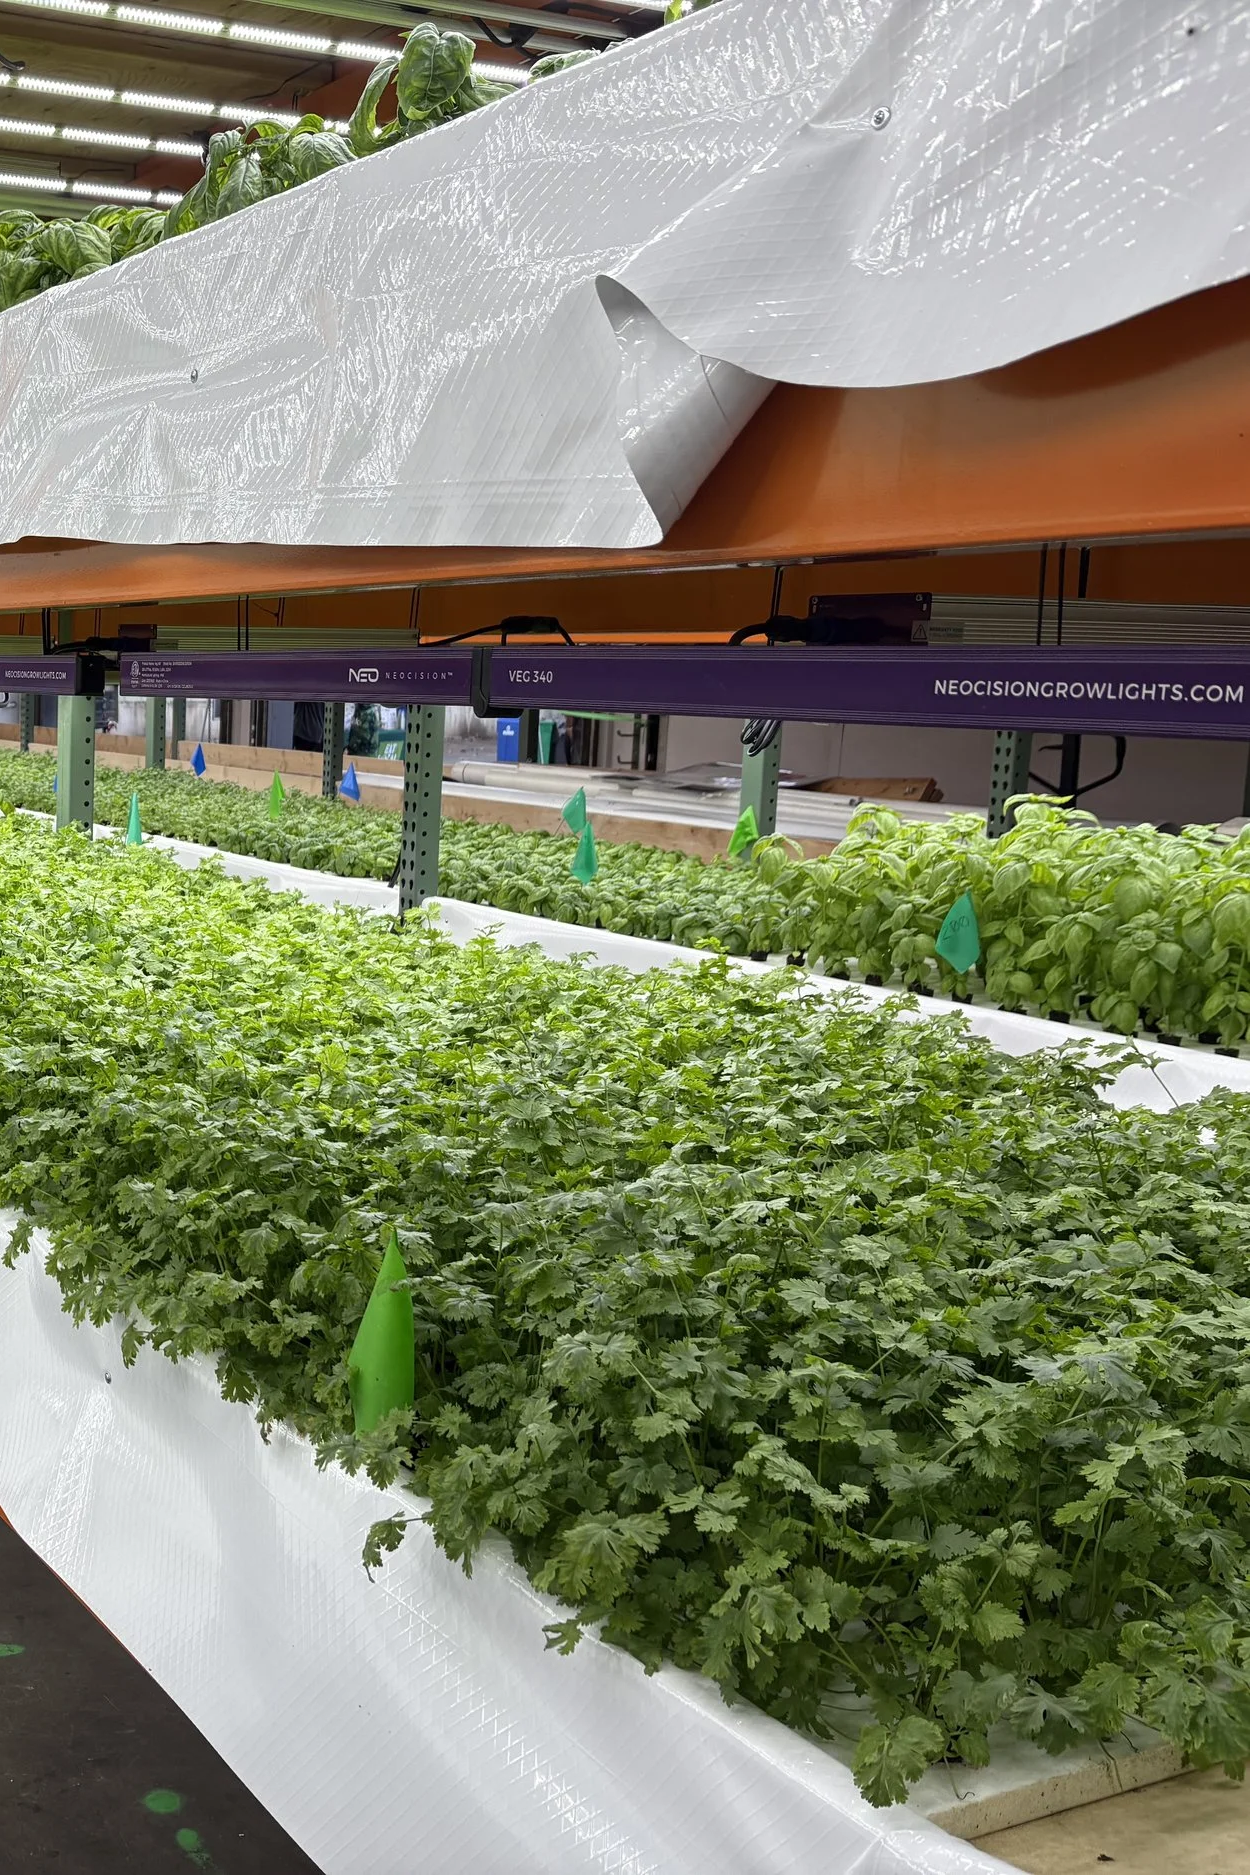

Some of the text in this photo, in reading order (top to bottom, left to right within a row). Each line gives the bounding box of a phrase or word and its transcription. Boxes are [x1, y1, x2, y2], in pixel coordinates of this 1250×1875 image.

[348, 668, 379, 683] NEO
[508, 670, 554, 683] VEG 340
[933, 679, 1245, 704] NEOCISIONGROWLIGHTS.COM
